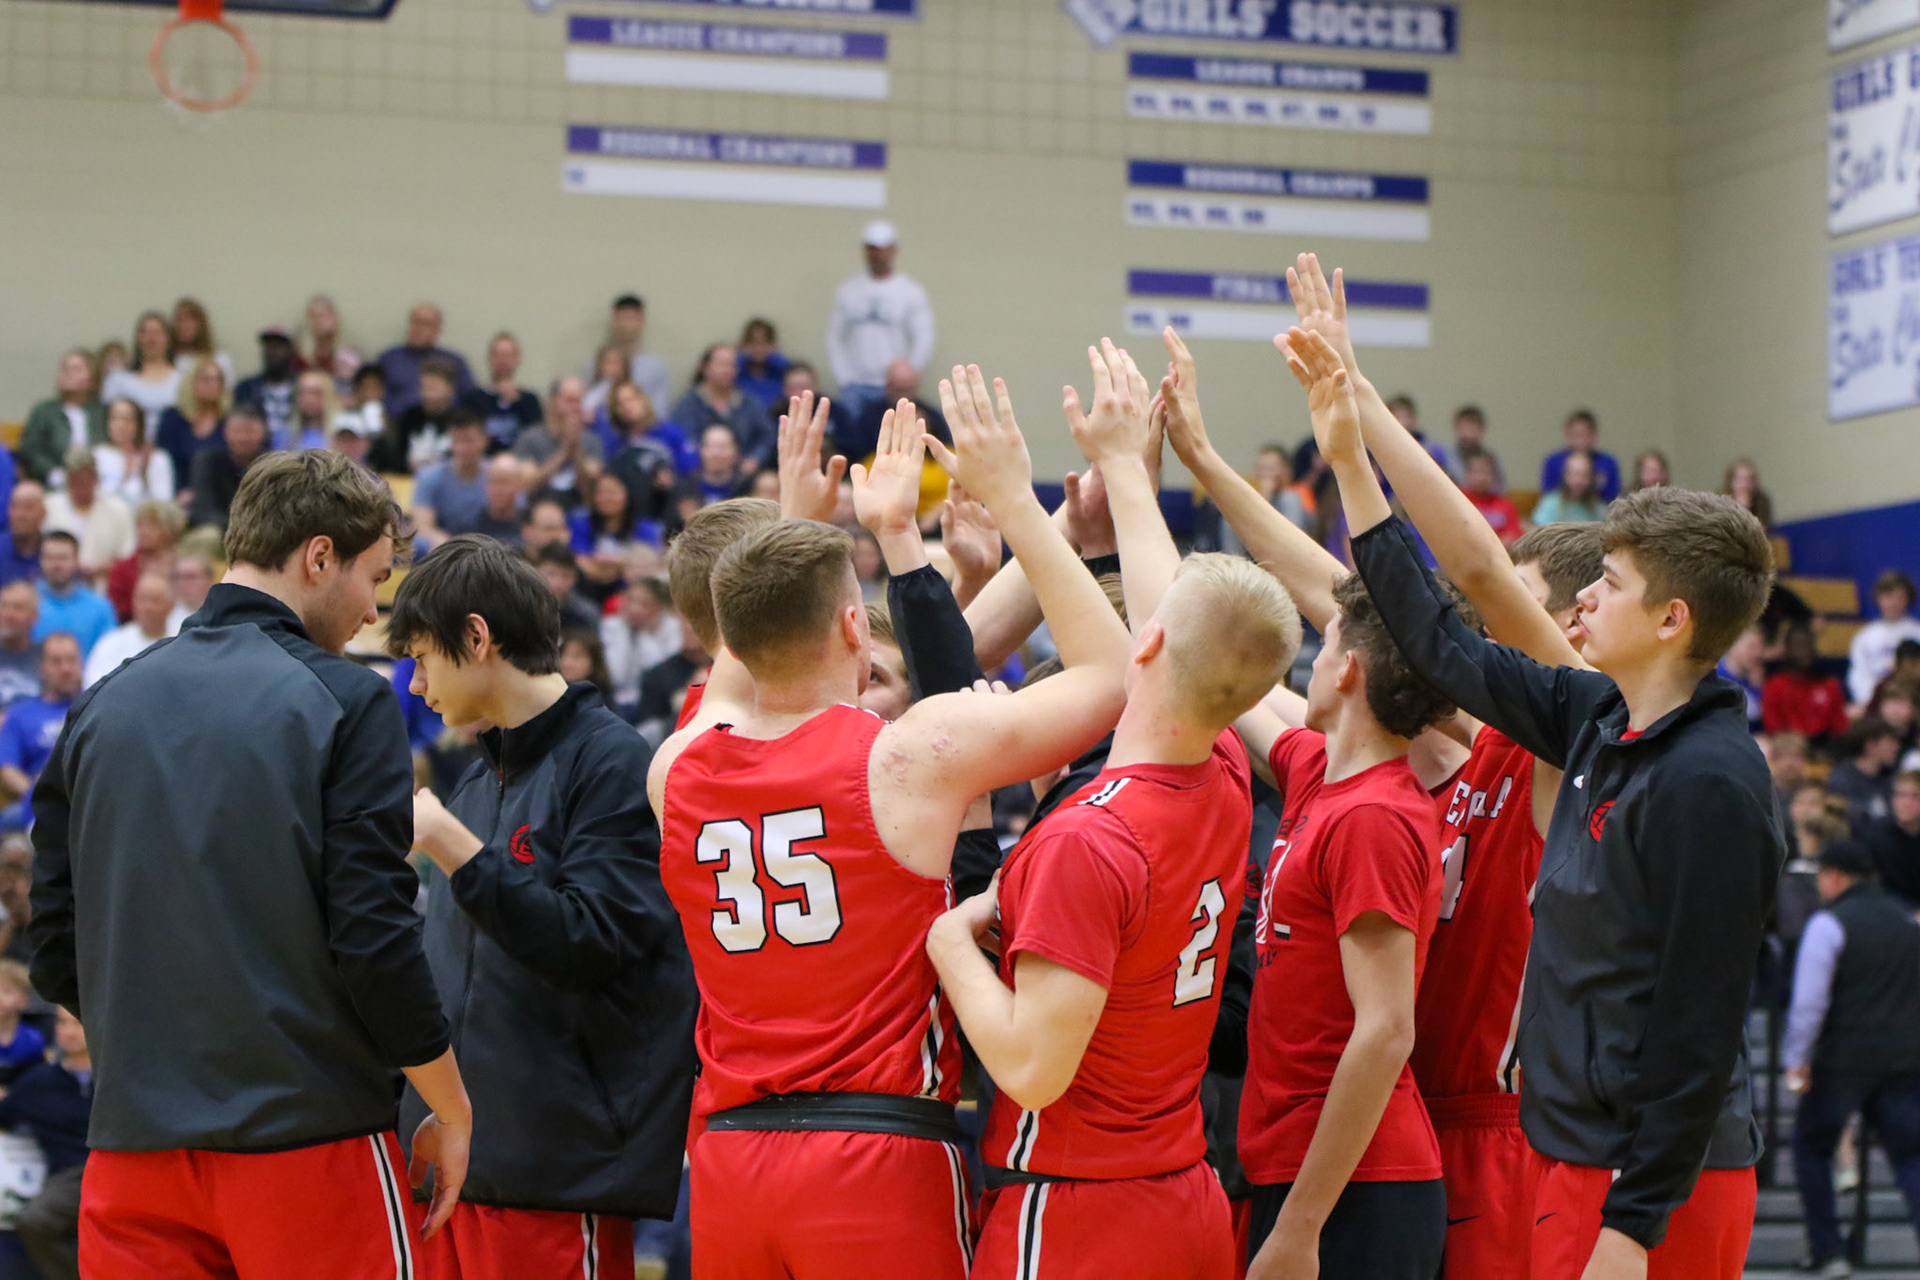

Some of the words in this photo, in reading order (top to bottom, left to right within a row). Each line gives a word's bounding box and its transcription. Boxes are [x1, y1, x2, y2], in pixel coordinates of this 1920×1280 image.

[1288, 2, 1445, 49] SOCCER
[695, 805, 843, 953] 35
[1171, 877, 1226, 1009] 2
